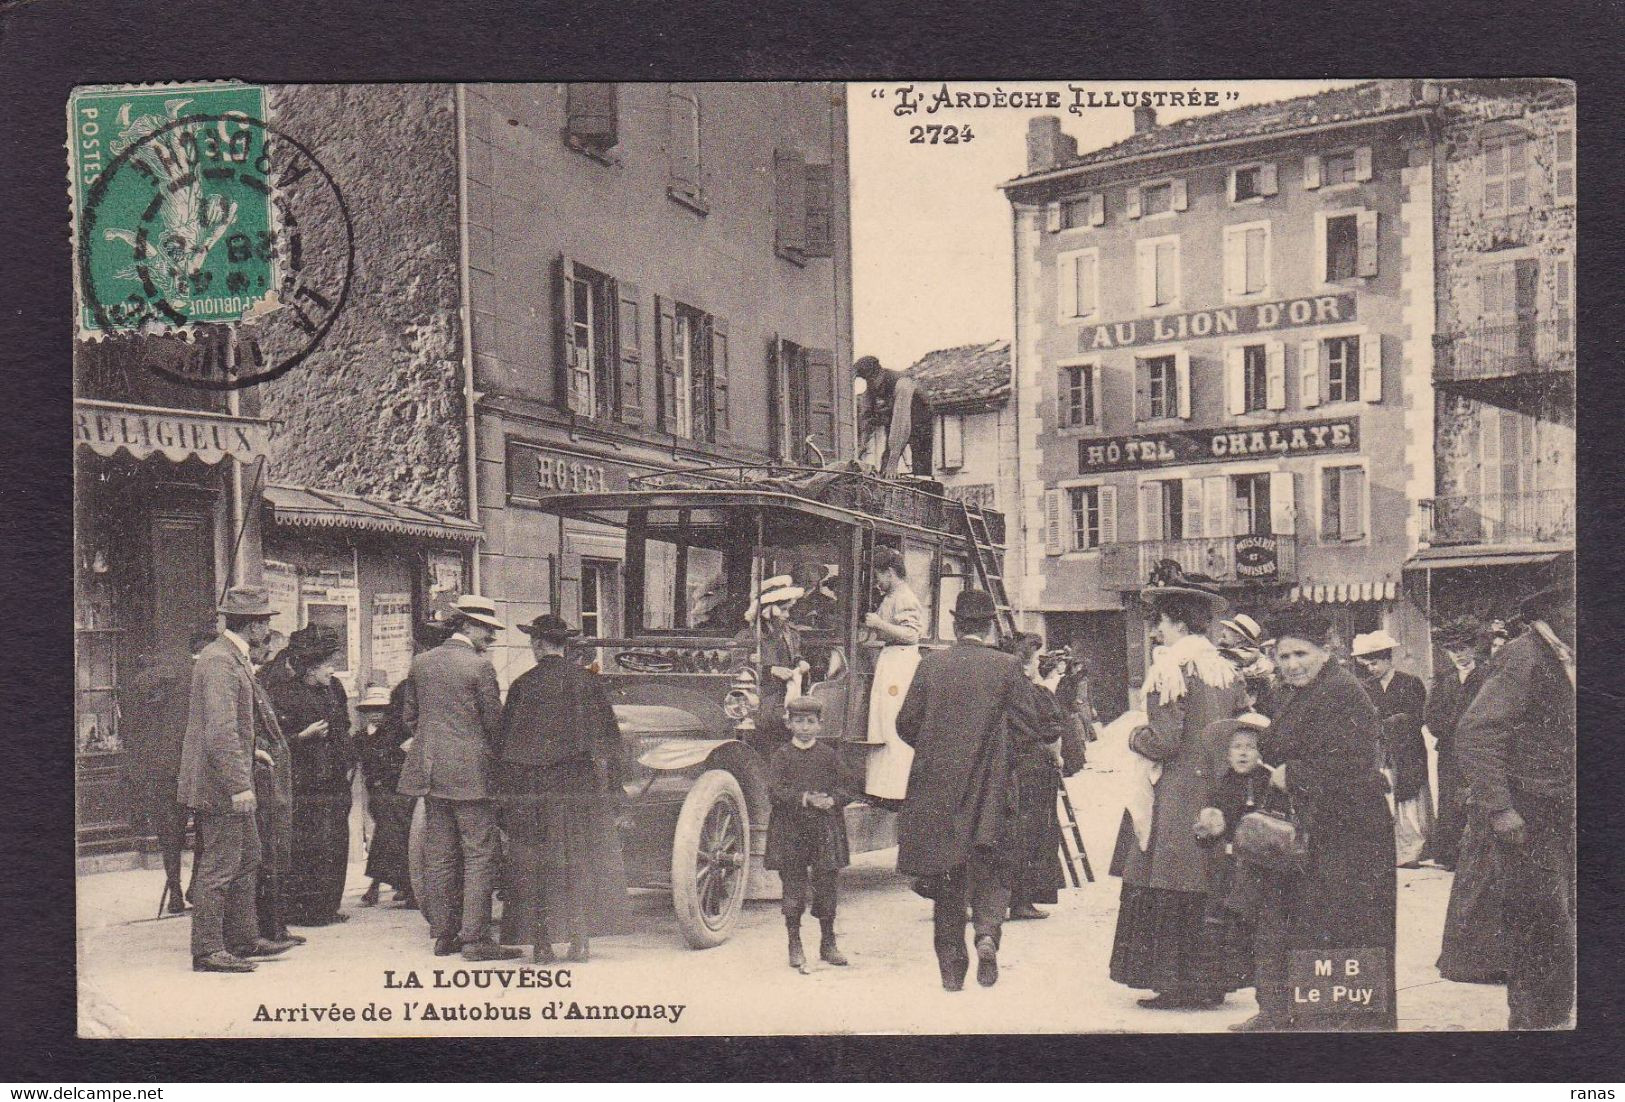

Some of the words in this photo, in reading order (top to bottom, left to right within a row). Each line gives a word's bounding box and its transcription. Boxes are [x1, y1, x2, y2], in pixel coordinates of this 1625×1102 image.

[80, 107, 100, 185] POSTES
[1091, 322, 1136, 349] AU
[1153, 308, 1239, 342] LION
[1256, 297, 1340, 328] D'OR
[75, 414, 251, 451] RELIGIEUX
[1211, 423, 1351, 456] CHALAYE
